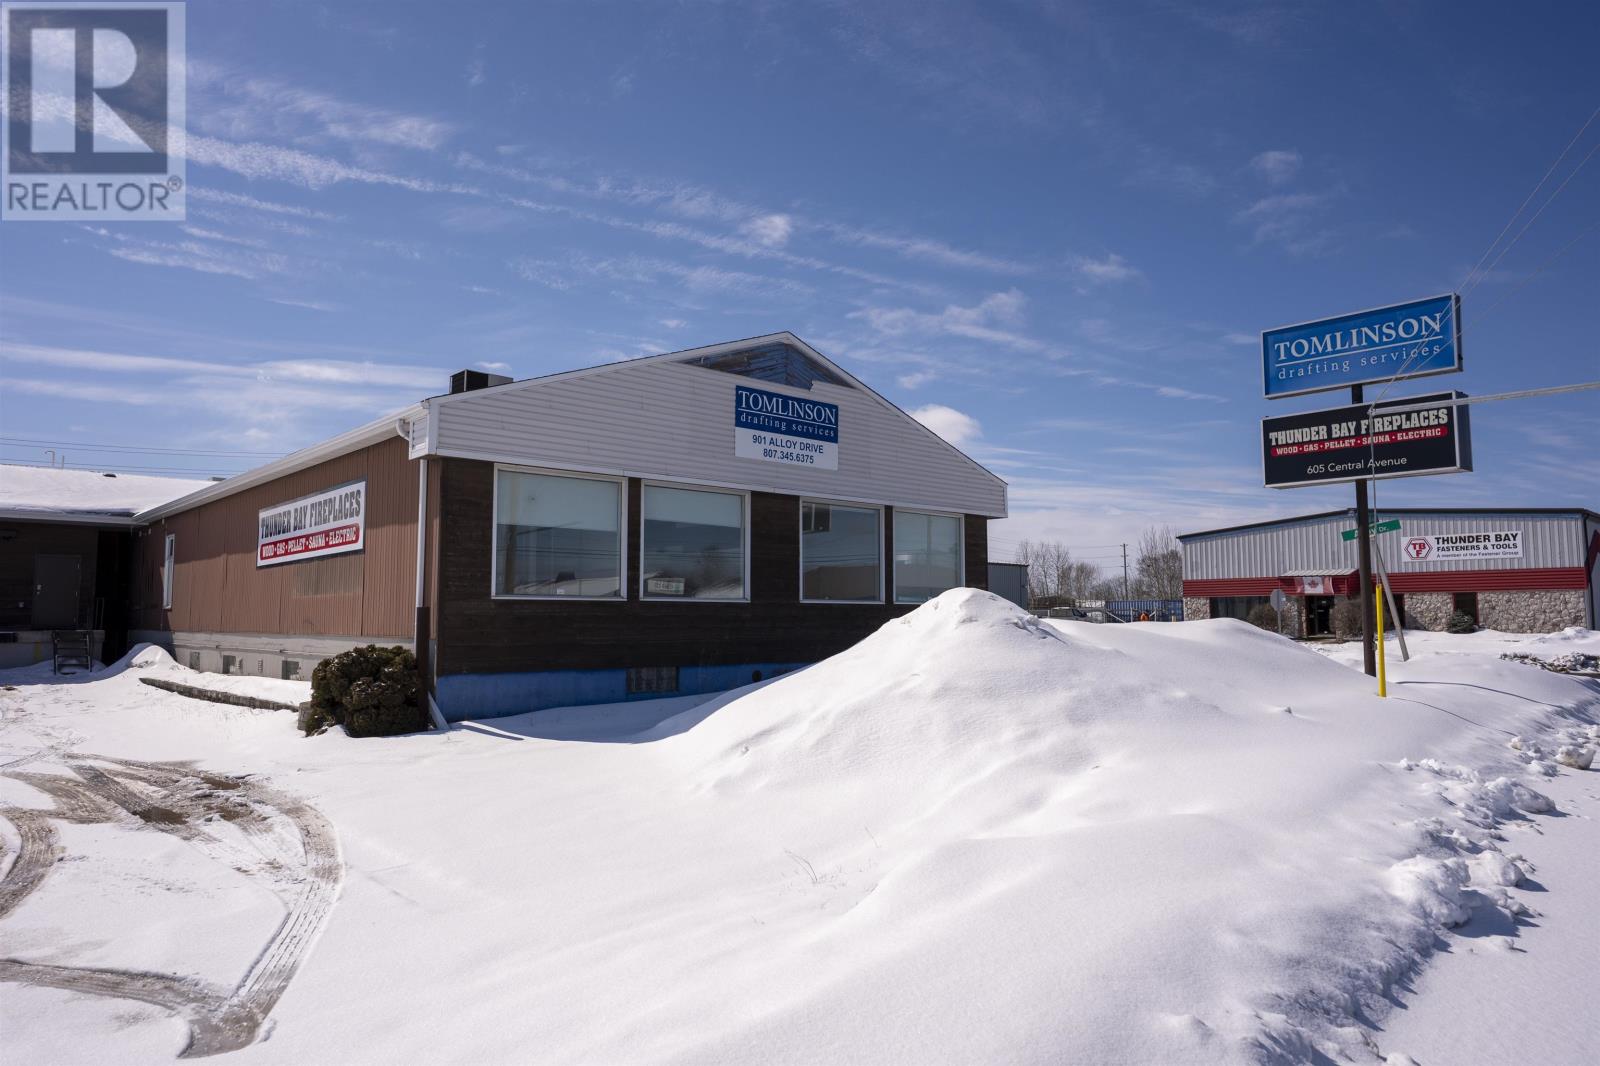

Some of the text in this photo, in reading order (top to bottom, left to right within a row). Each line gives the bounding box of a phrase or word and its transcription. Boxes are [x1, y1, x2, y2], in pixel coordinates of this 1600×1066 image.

[1274, 312, 1442, 361] TOMLINSON
[1278, 344, 1441, 380] drafting services
[738, 390, 836, 424] TOMLINSON
[740, 412, 835, 437] drafting services
[1269, 425, 1328, 446] THUNDER
[1331, 421, 1357, 437] BAY
[752, 434, 824, 453] 901 ALLOY DRIVE
[1276, 446, 1298, 455] WOOD
[1303, 443, 1319, 452] GAS
[1324, 438, 1356, 450] PELLET
[1397, 428, 1441, 441] ELECTRIC
[763, 448, 814, 464] 807.345.6375
[1306, 456, 1408, 475] 605 Central Avenue
[260, 489, 362, 540] THUNDER BAY FIREPLACES
[329, 527, 357, 545] ELECTRIC
[1434, 532, 1519, 545] THUNDER BAY
[1436, 542, 1518, 553] FASTENERS & TOOLS
